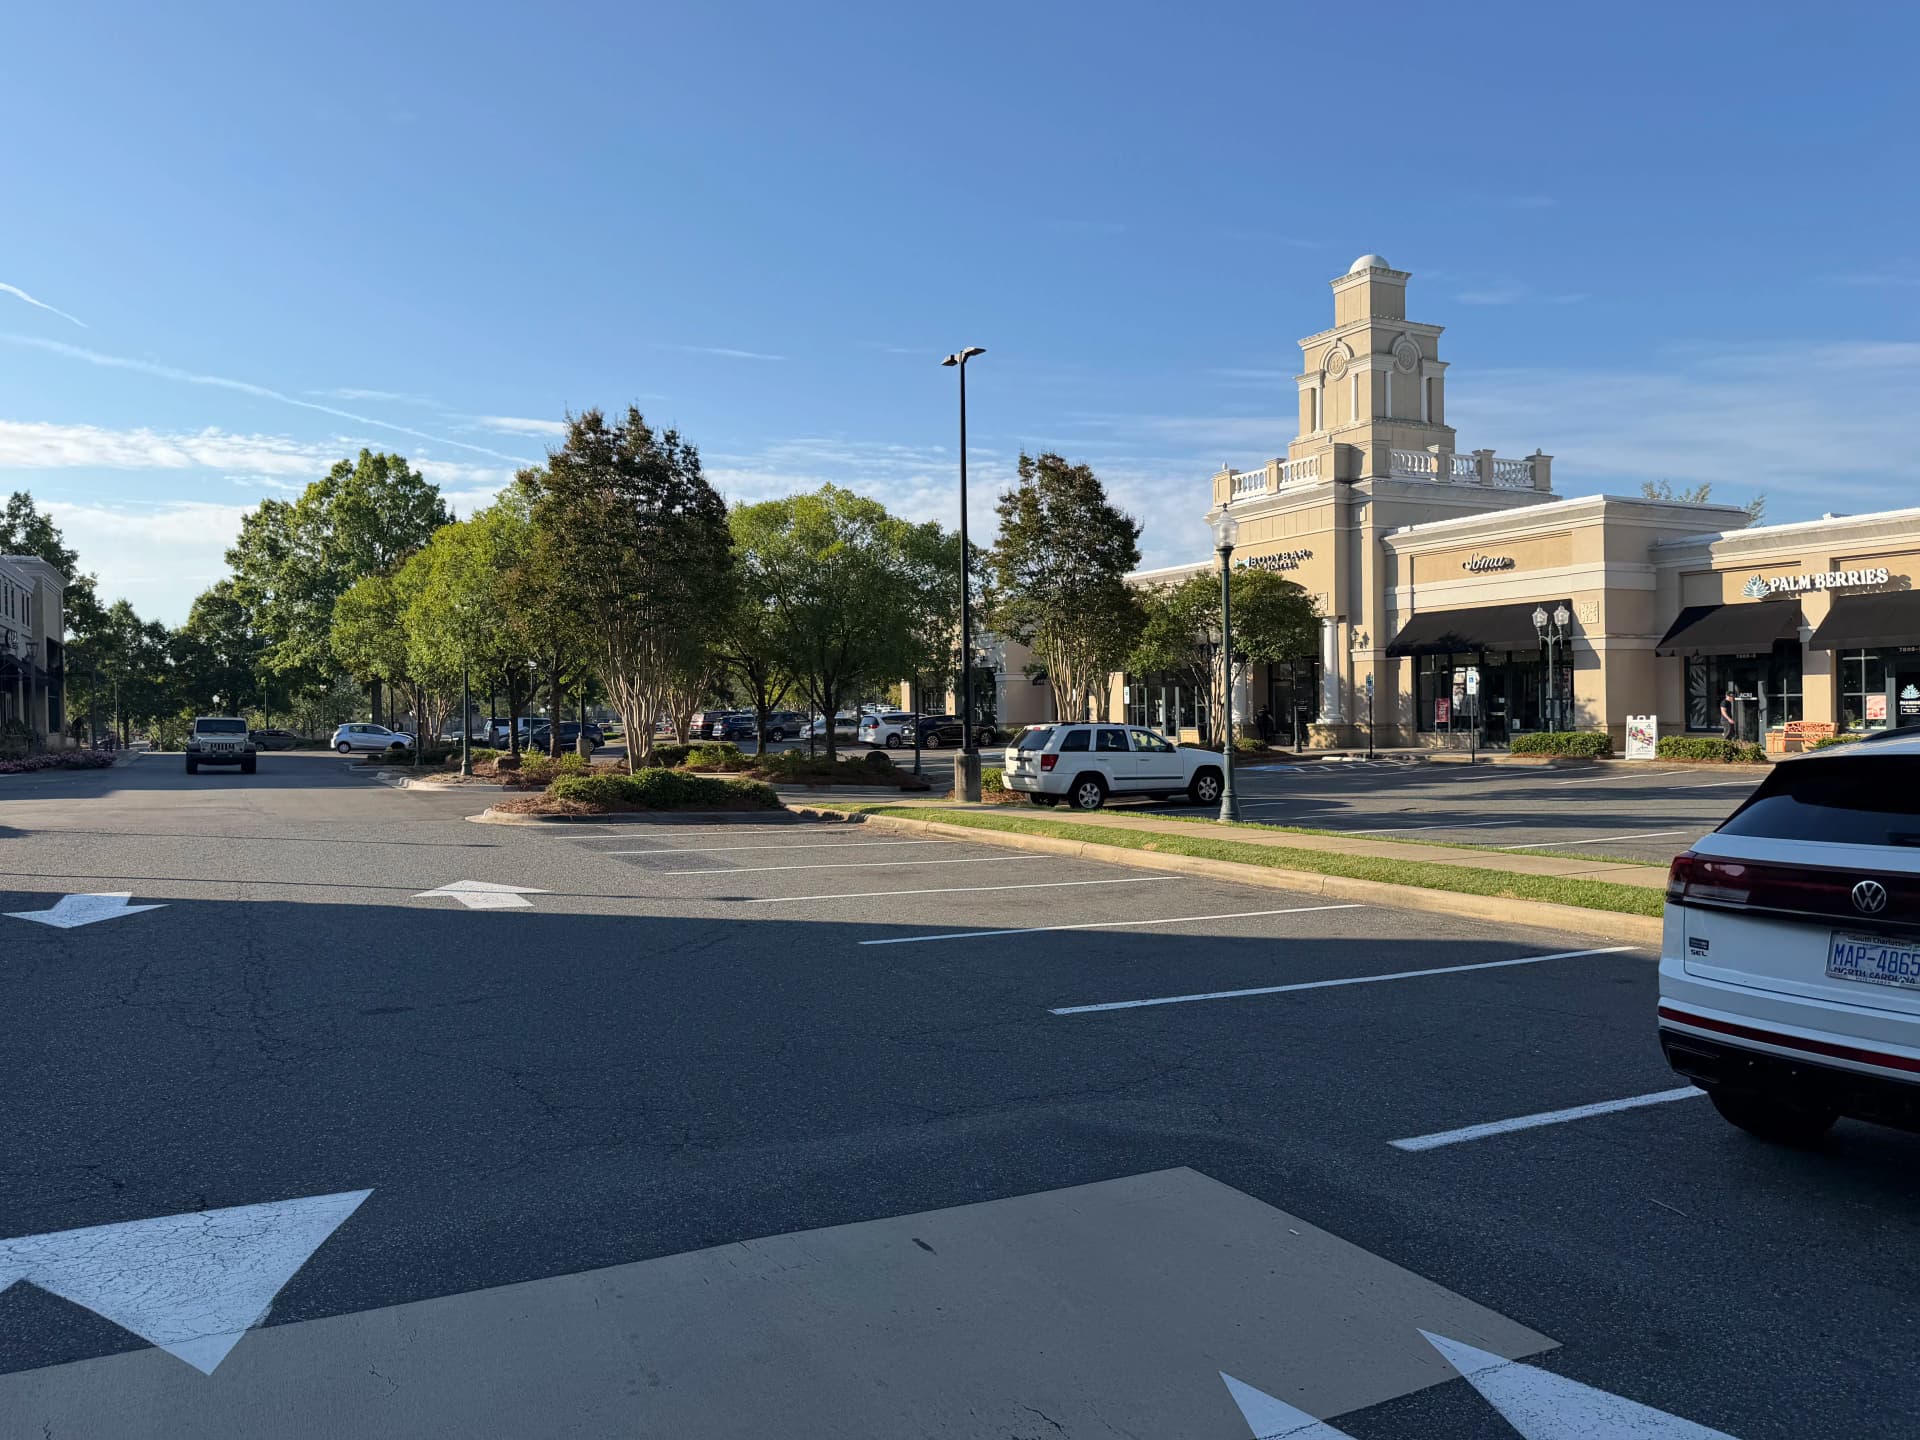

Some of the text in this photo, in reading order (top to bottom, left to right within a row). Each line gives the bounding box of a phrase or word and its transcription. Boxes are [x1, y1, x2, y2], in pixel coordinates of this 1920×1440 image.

[1250, 549, 1307, 567] BODYBAR
[1465, 552, 1506, 570] Soma
[1769, 567, 1889, 592] PALM BERRIES
[1833, 944, 1920, 976] MAP-4865
